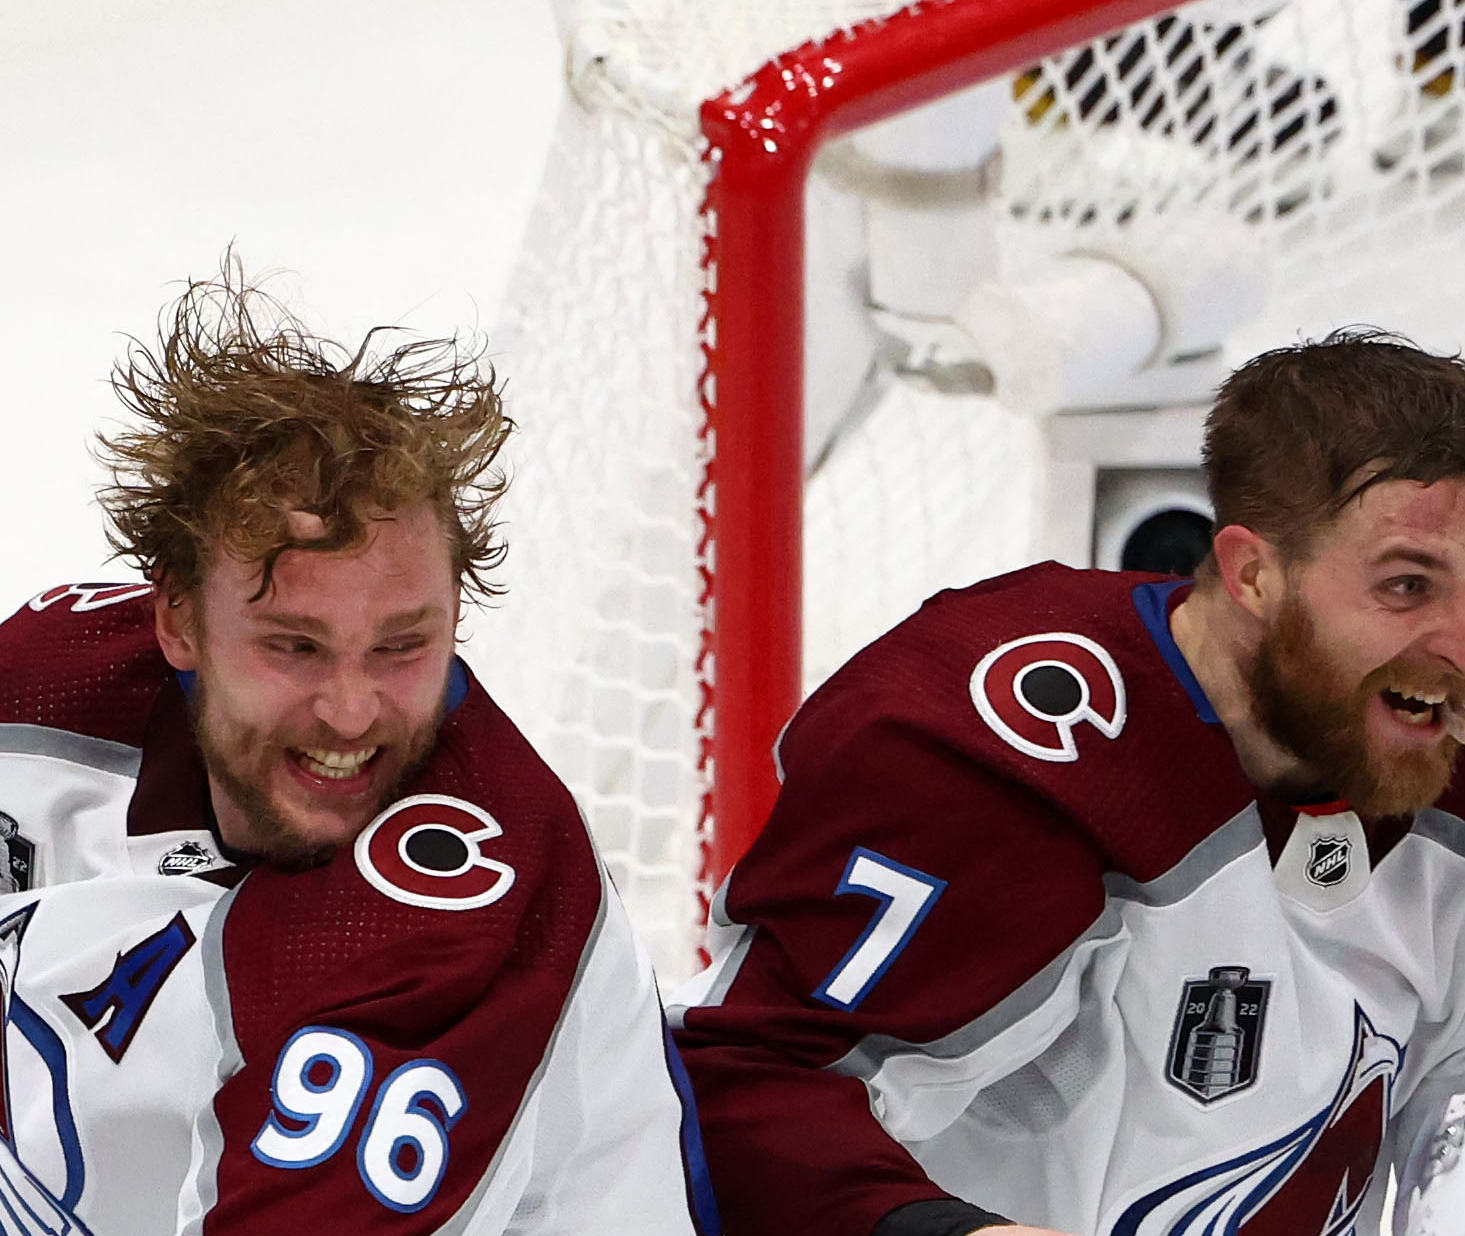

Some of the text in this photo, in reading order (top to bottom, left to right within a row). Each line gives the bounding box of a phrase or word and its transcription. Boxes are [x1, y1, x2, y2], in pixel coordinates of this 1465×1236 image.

[11, 855, 28, 872] 22
[812, 846, 947, 1012] 7
[57, 910, 197, 1065] A
[1186, 1001, 1259, 1017] 20 22
[250, 1026, 468, 1214] 96
